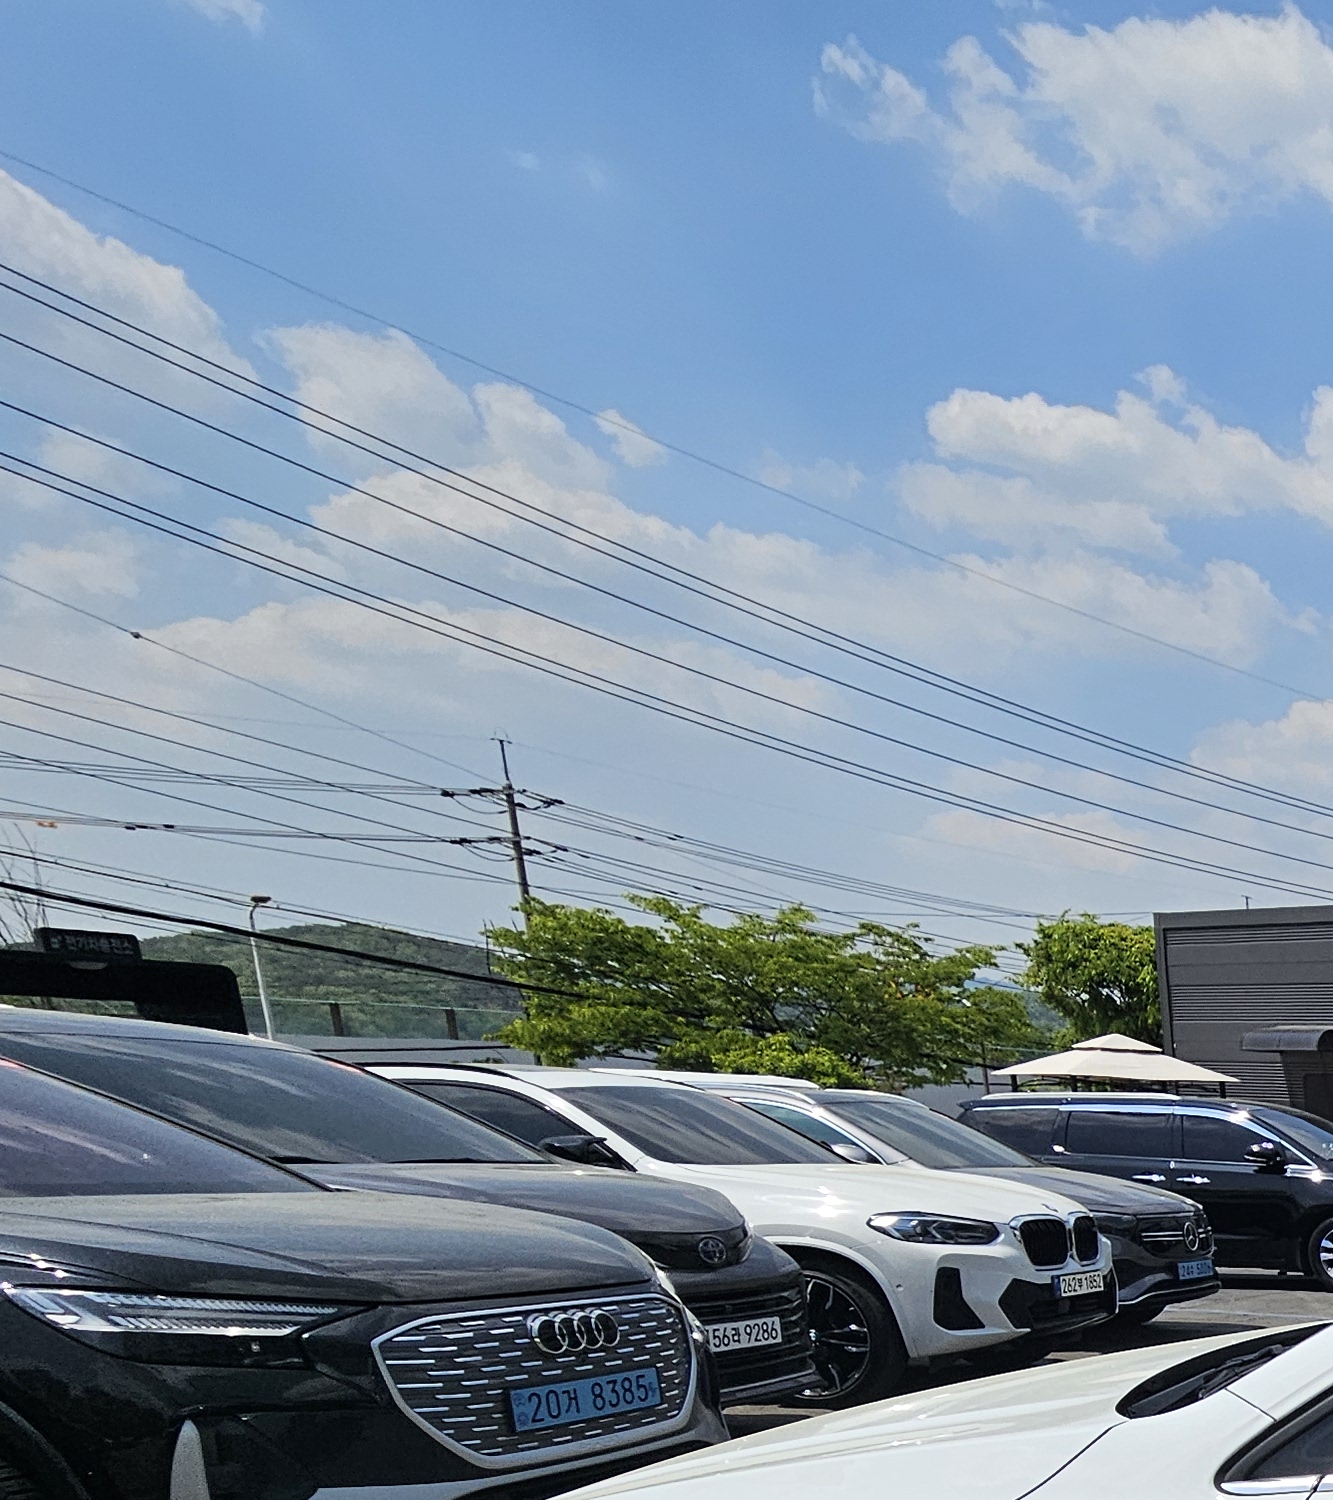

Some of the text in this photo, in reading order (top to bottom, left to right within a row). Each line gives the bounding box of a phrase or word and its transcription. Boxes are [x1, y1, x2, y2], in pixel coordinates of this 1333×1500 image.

[743, 1320, 778, 1344] 9286
[527, 1387, 581, 1424] 20거
[590, 1374, 649, 1412] 8385
